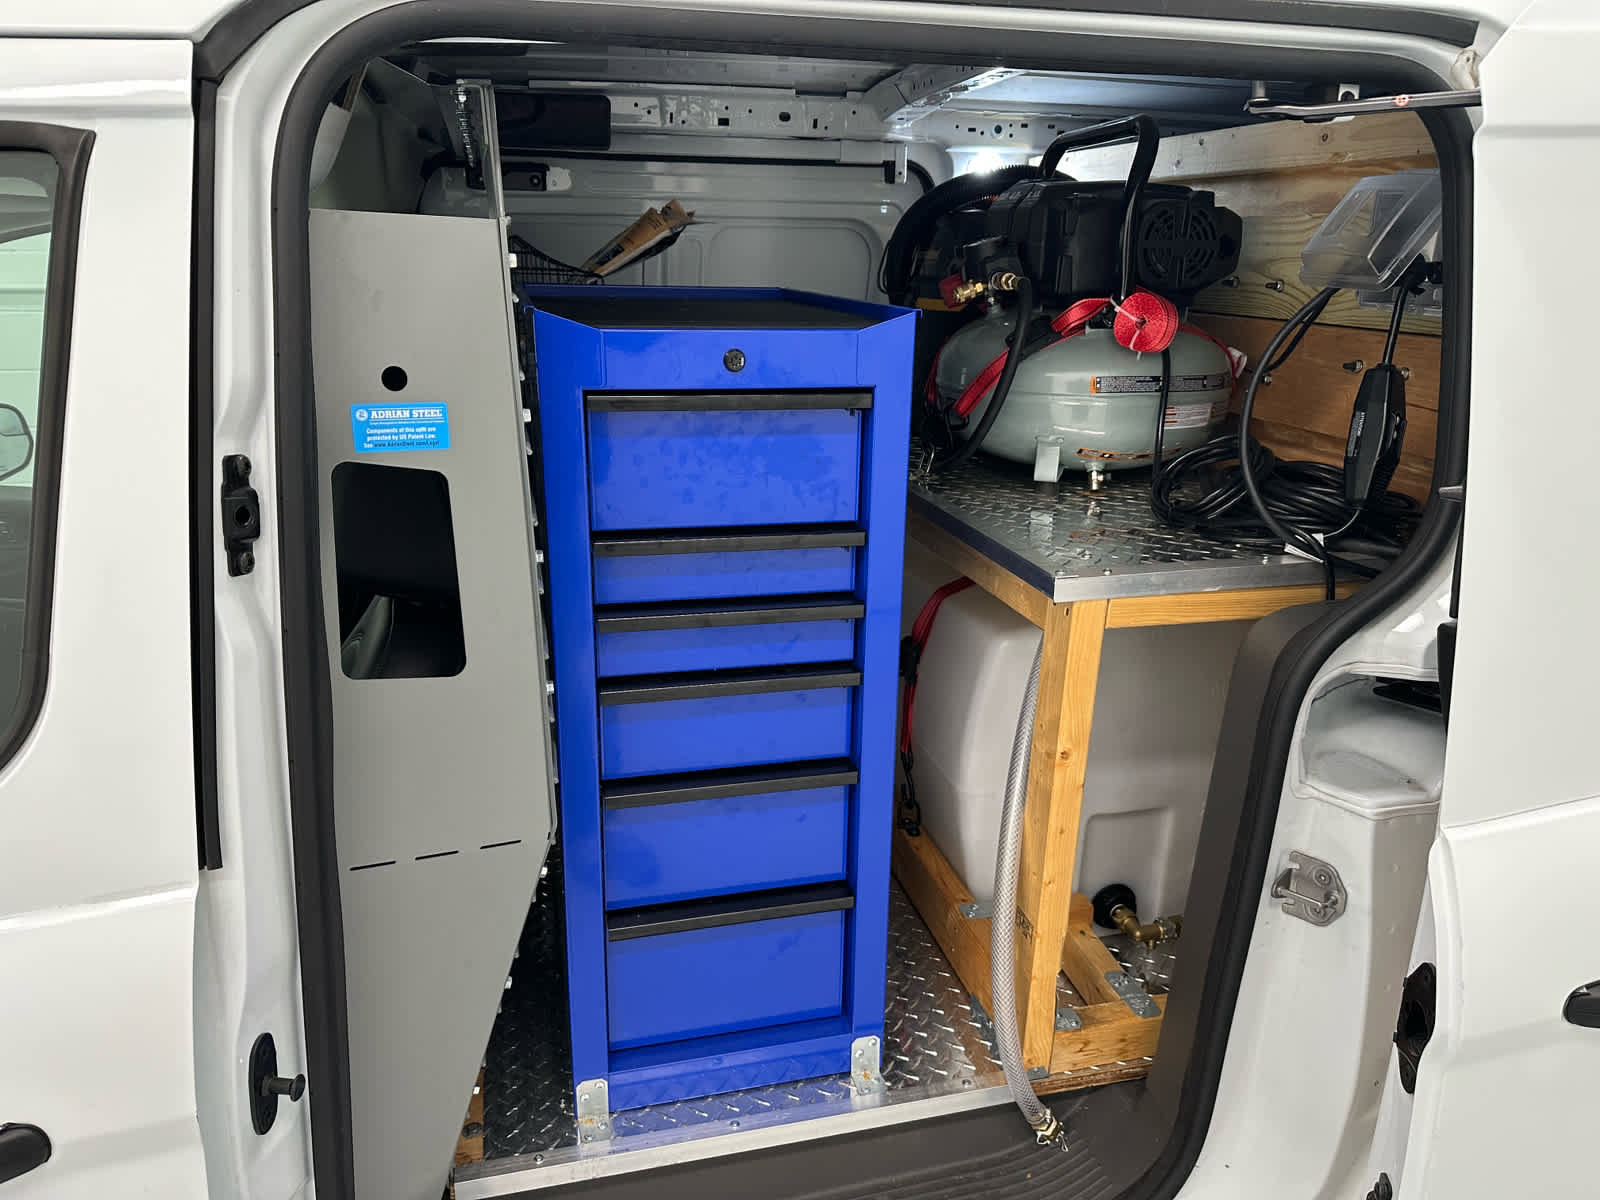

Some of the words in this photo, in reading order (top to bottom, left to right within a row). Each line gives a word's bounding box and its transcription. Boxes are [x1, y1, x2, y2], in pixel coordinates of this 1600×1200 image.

[371, 410, 410, 419] ADRIAN
[412, 409, 443, 418] STEEL
[366, 427, 398, 435] Components
